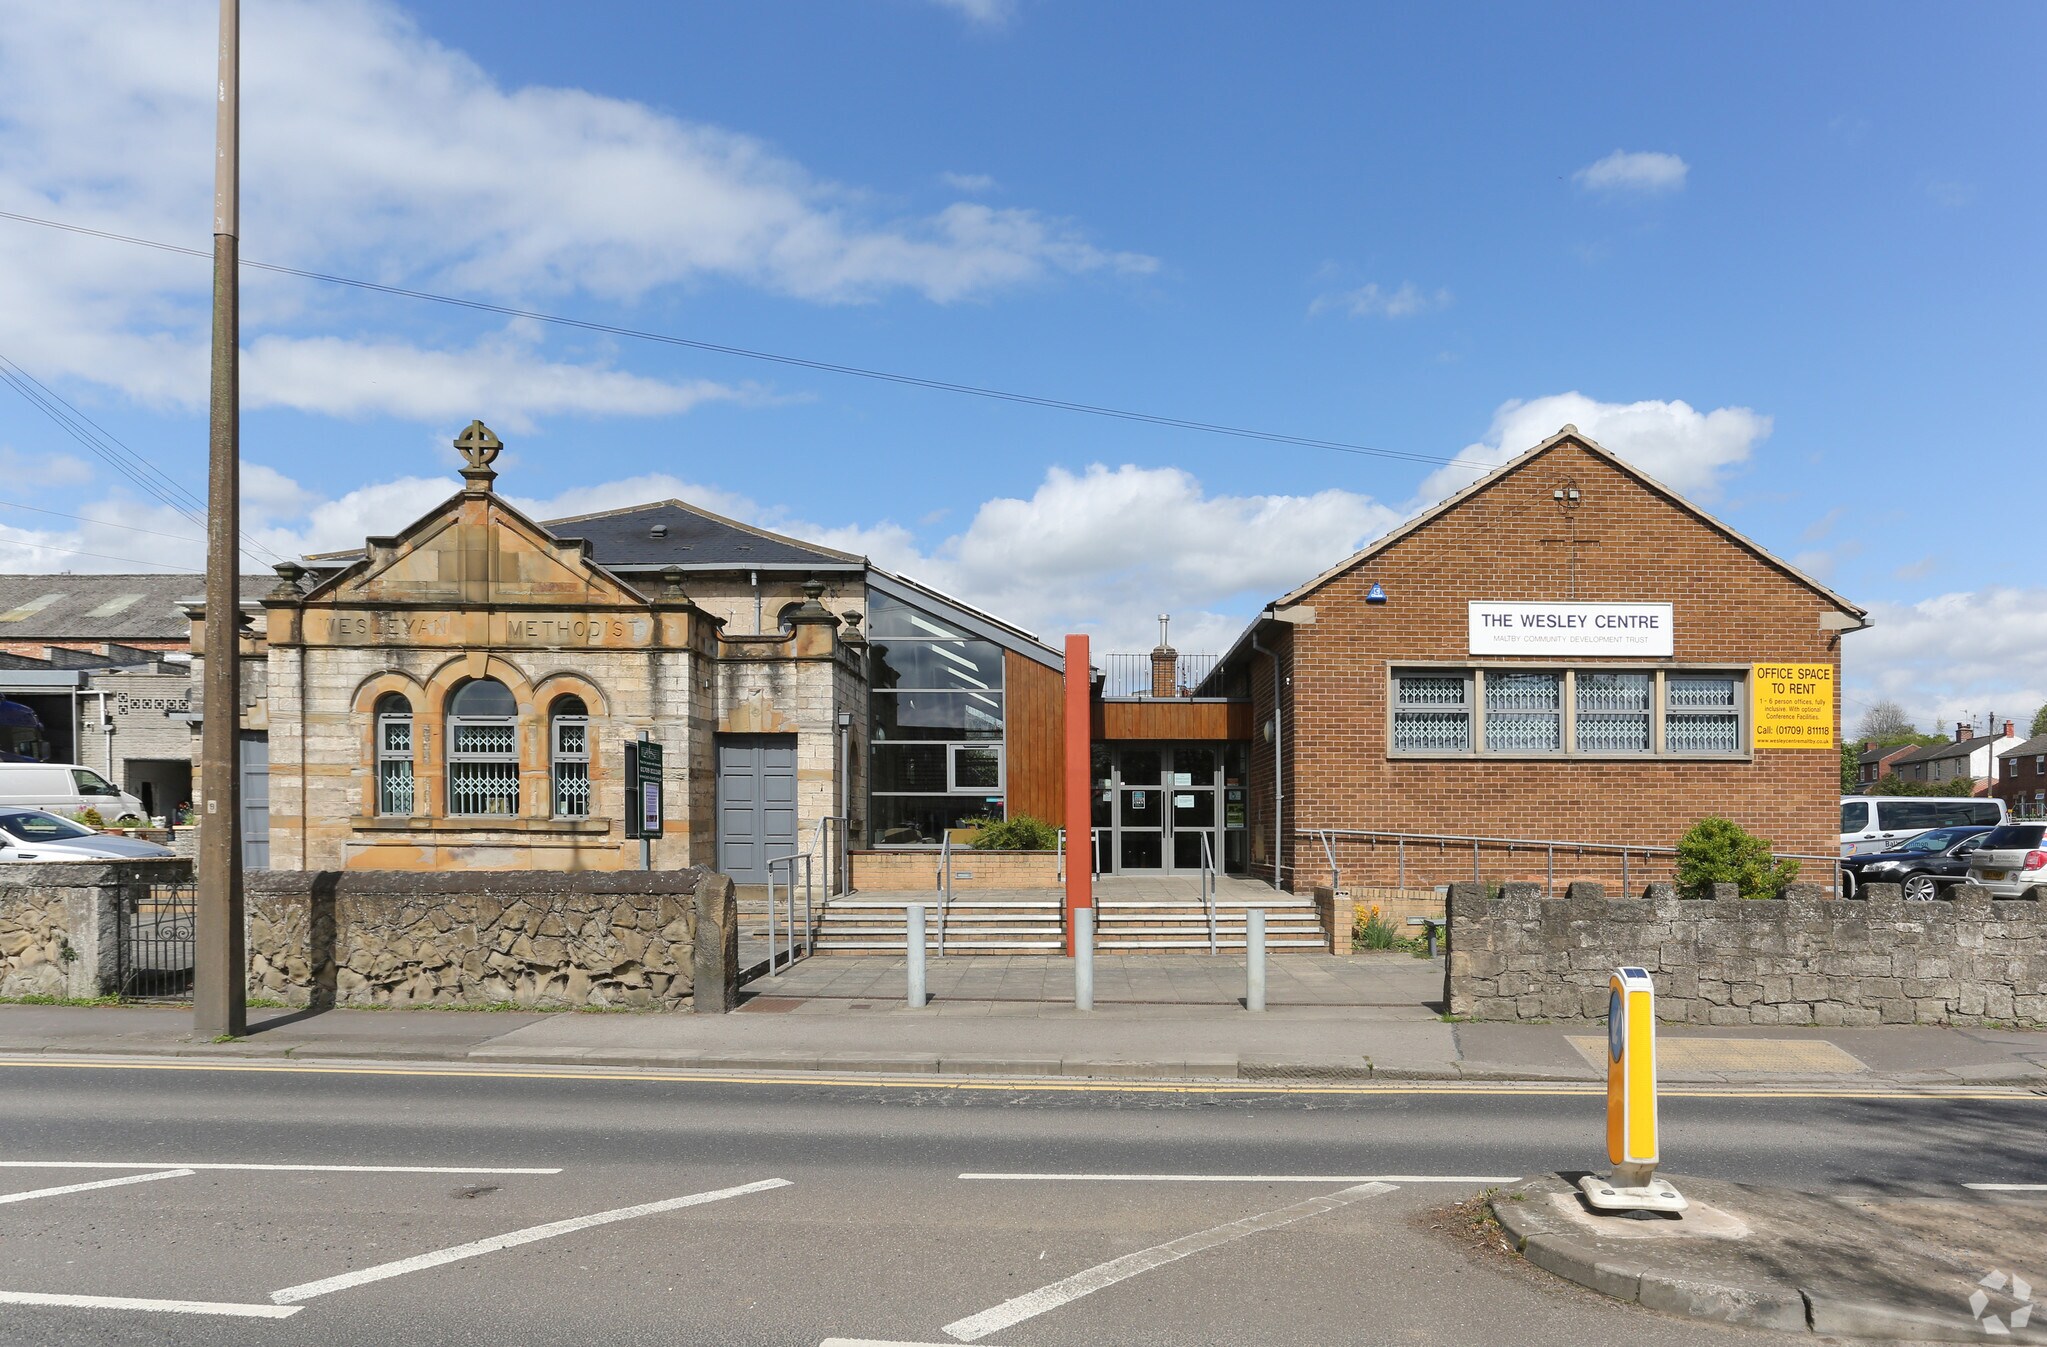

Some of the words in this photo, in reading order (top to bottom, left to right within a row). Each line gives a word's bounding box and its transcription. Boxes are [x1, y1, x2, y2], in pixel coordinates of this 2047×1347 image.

[1481, 613, 1513, 627] THE
[1520, 614, 1587, 628] WESLEY
[1595, 615, 1659, 629] CENTRE
[1524, 635, 1567, 643] COMMUNITY
[1757, 667, 1793, 679] OFFICE
[1798, 668, 1830, 680] SPACE
[1772, 683, 1785, 694] TO
[1790, 683, 1816, 694] RENT
[1757, 726, 1772, 734] Call:
[1776, 726, 1804, 735] (01709)
